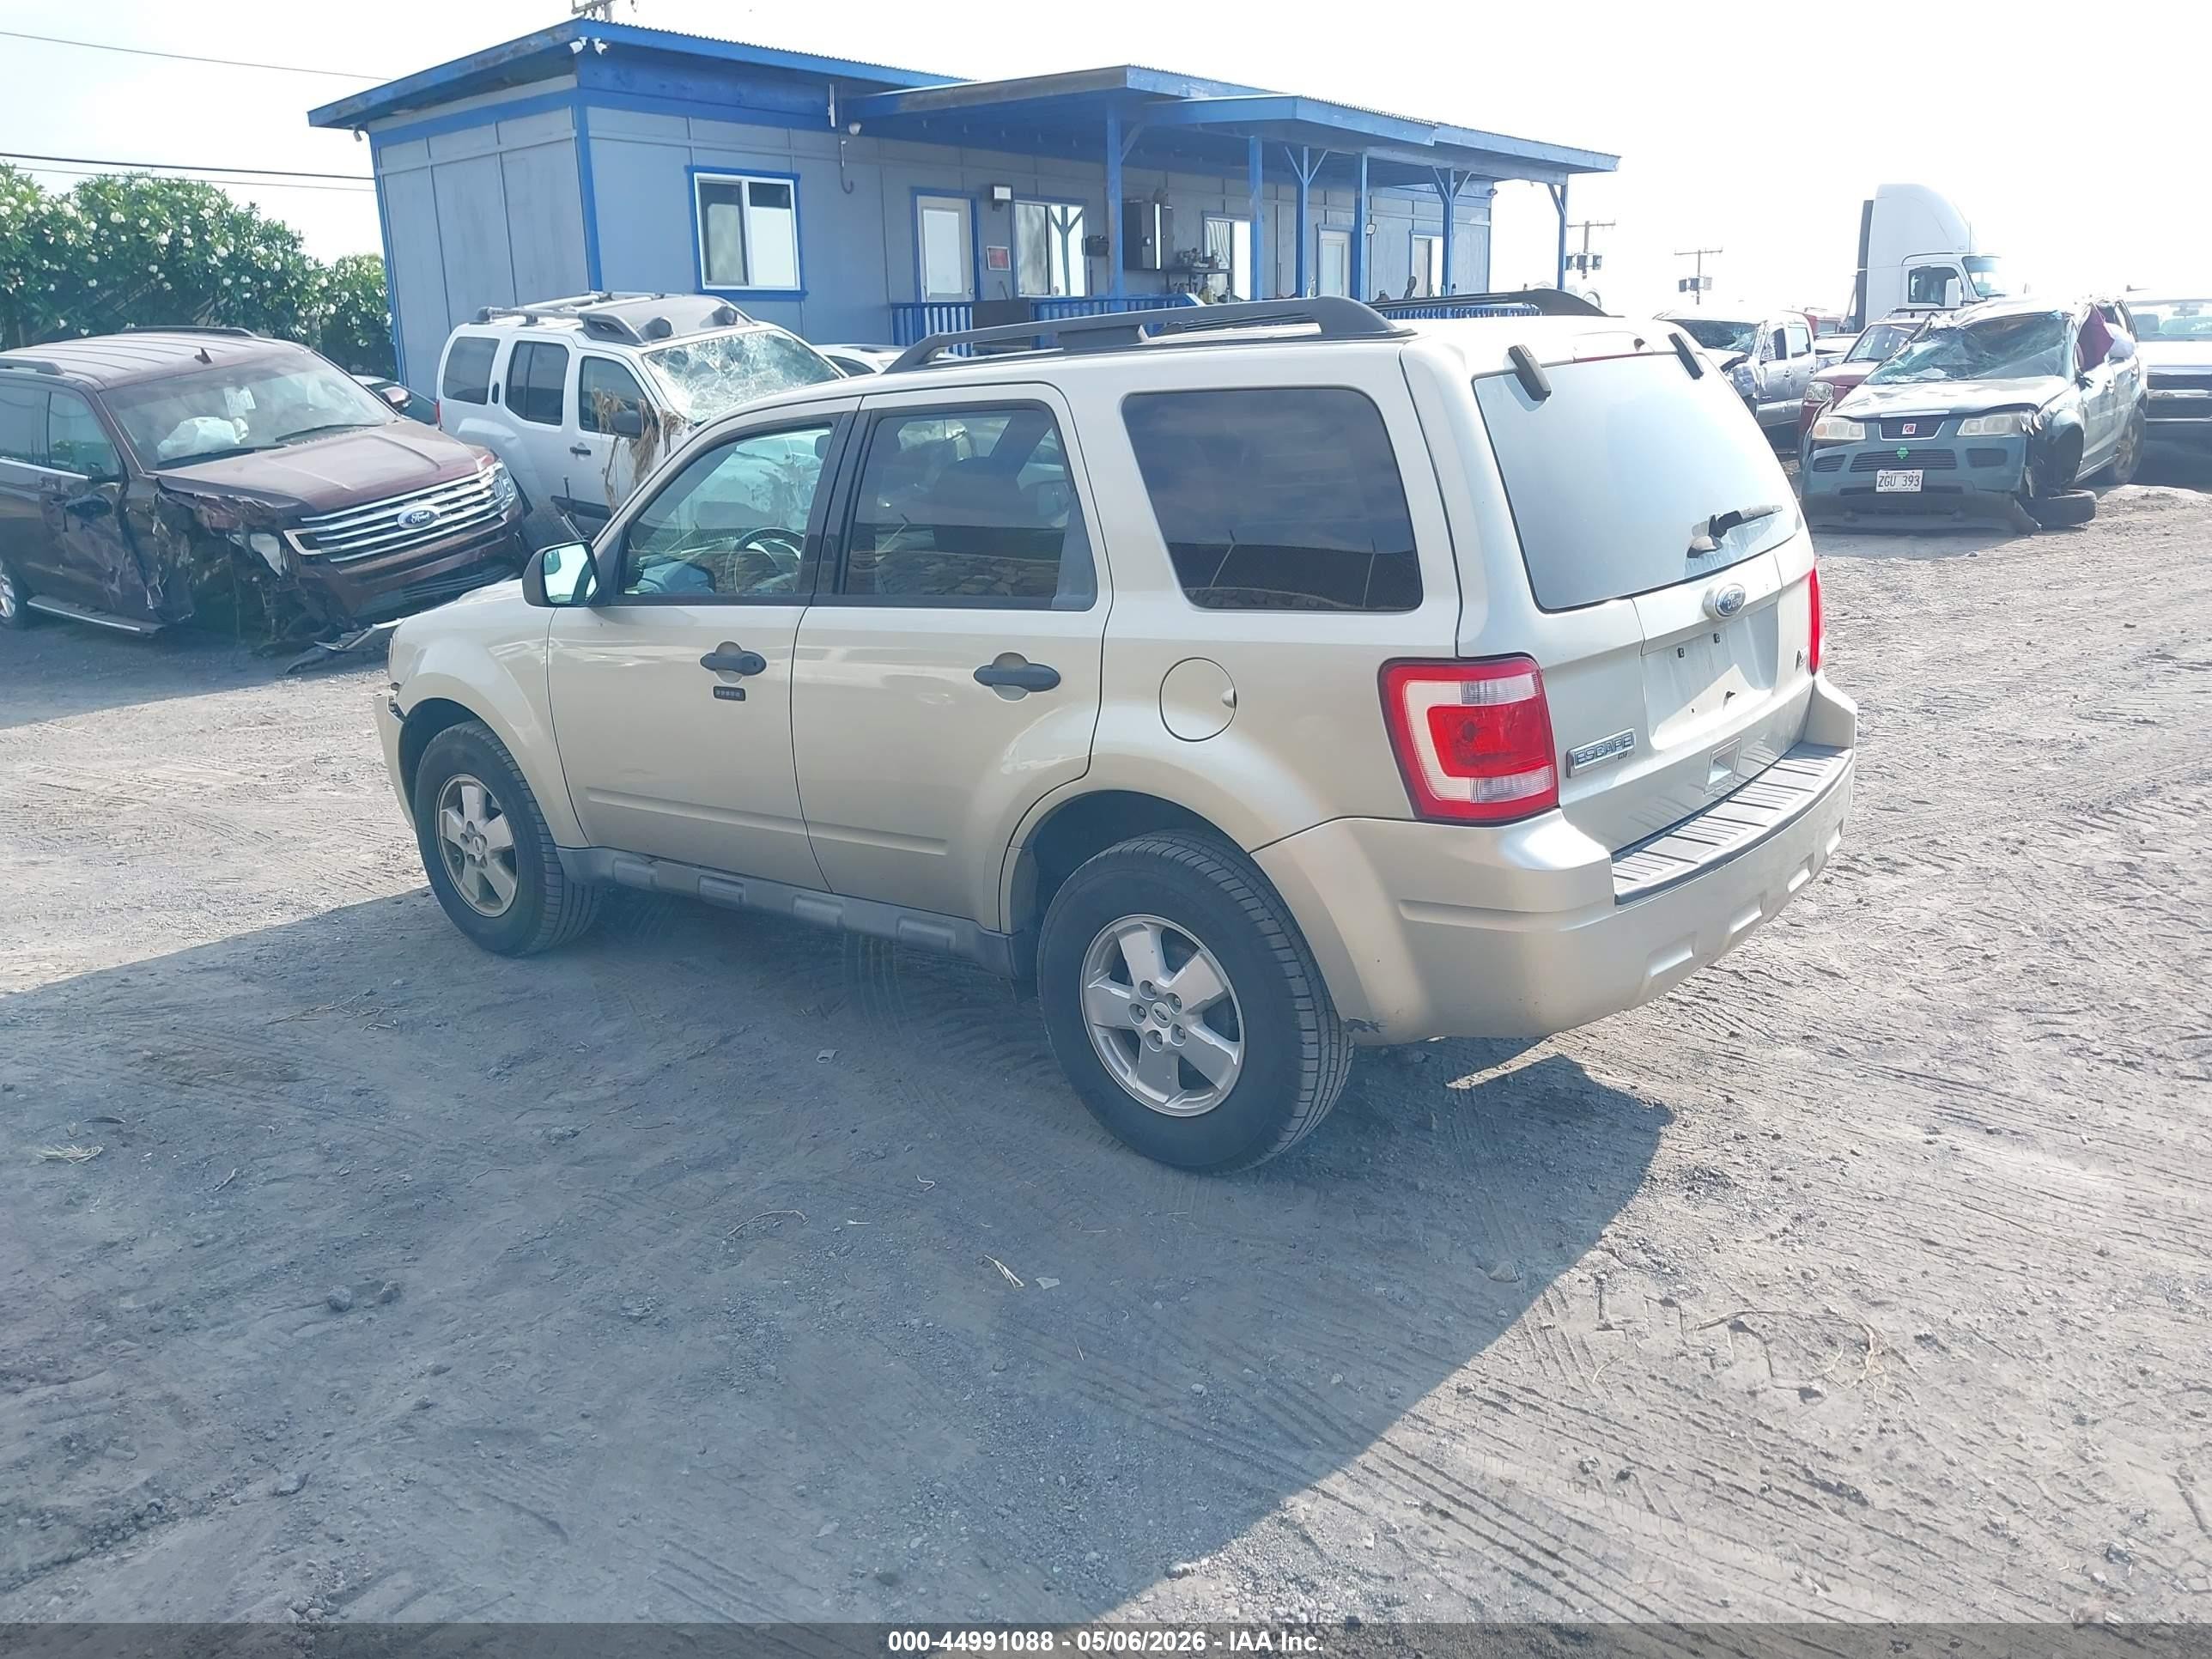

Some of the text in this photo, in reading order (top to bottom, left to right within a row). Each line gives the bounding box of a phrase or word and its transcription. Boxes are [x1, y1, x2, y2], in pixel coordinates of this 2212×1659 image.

[1878, 475, 1920, 488] ZGU 393
[410, 511, 431, 524] Ford
[1726, 590, 1743, 610] Ford
[1577, 732, 1633, 765] ESCAPE
